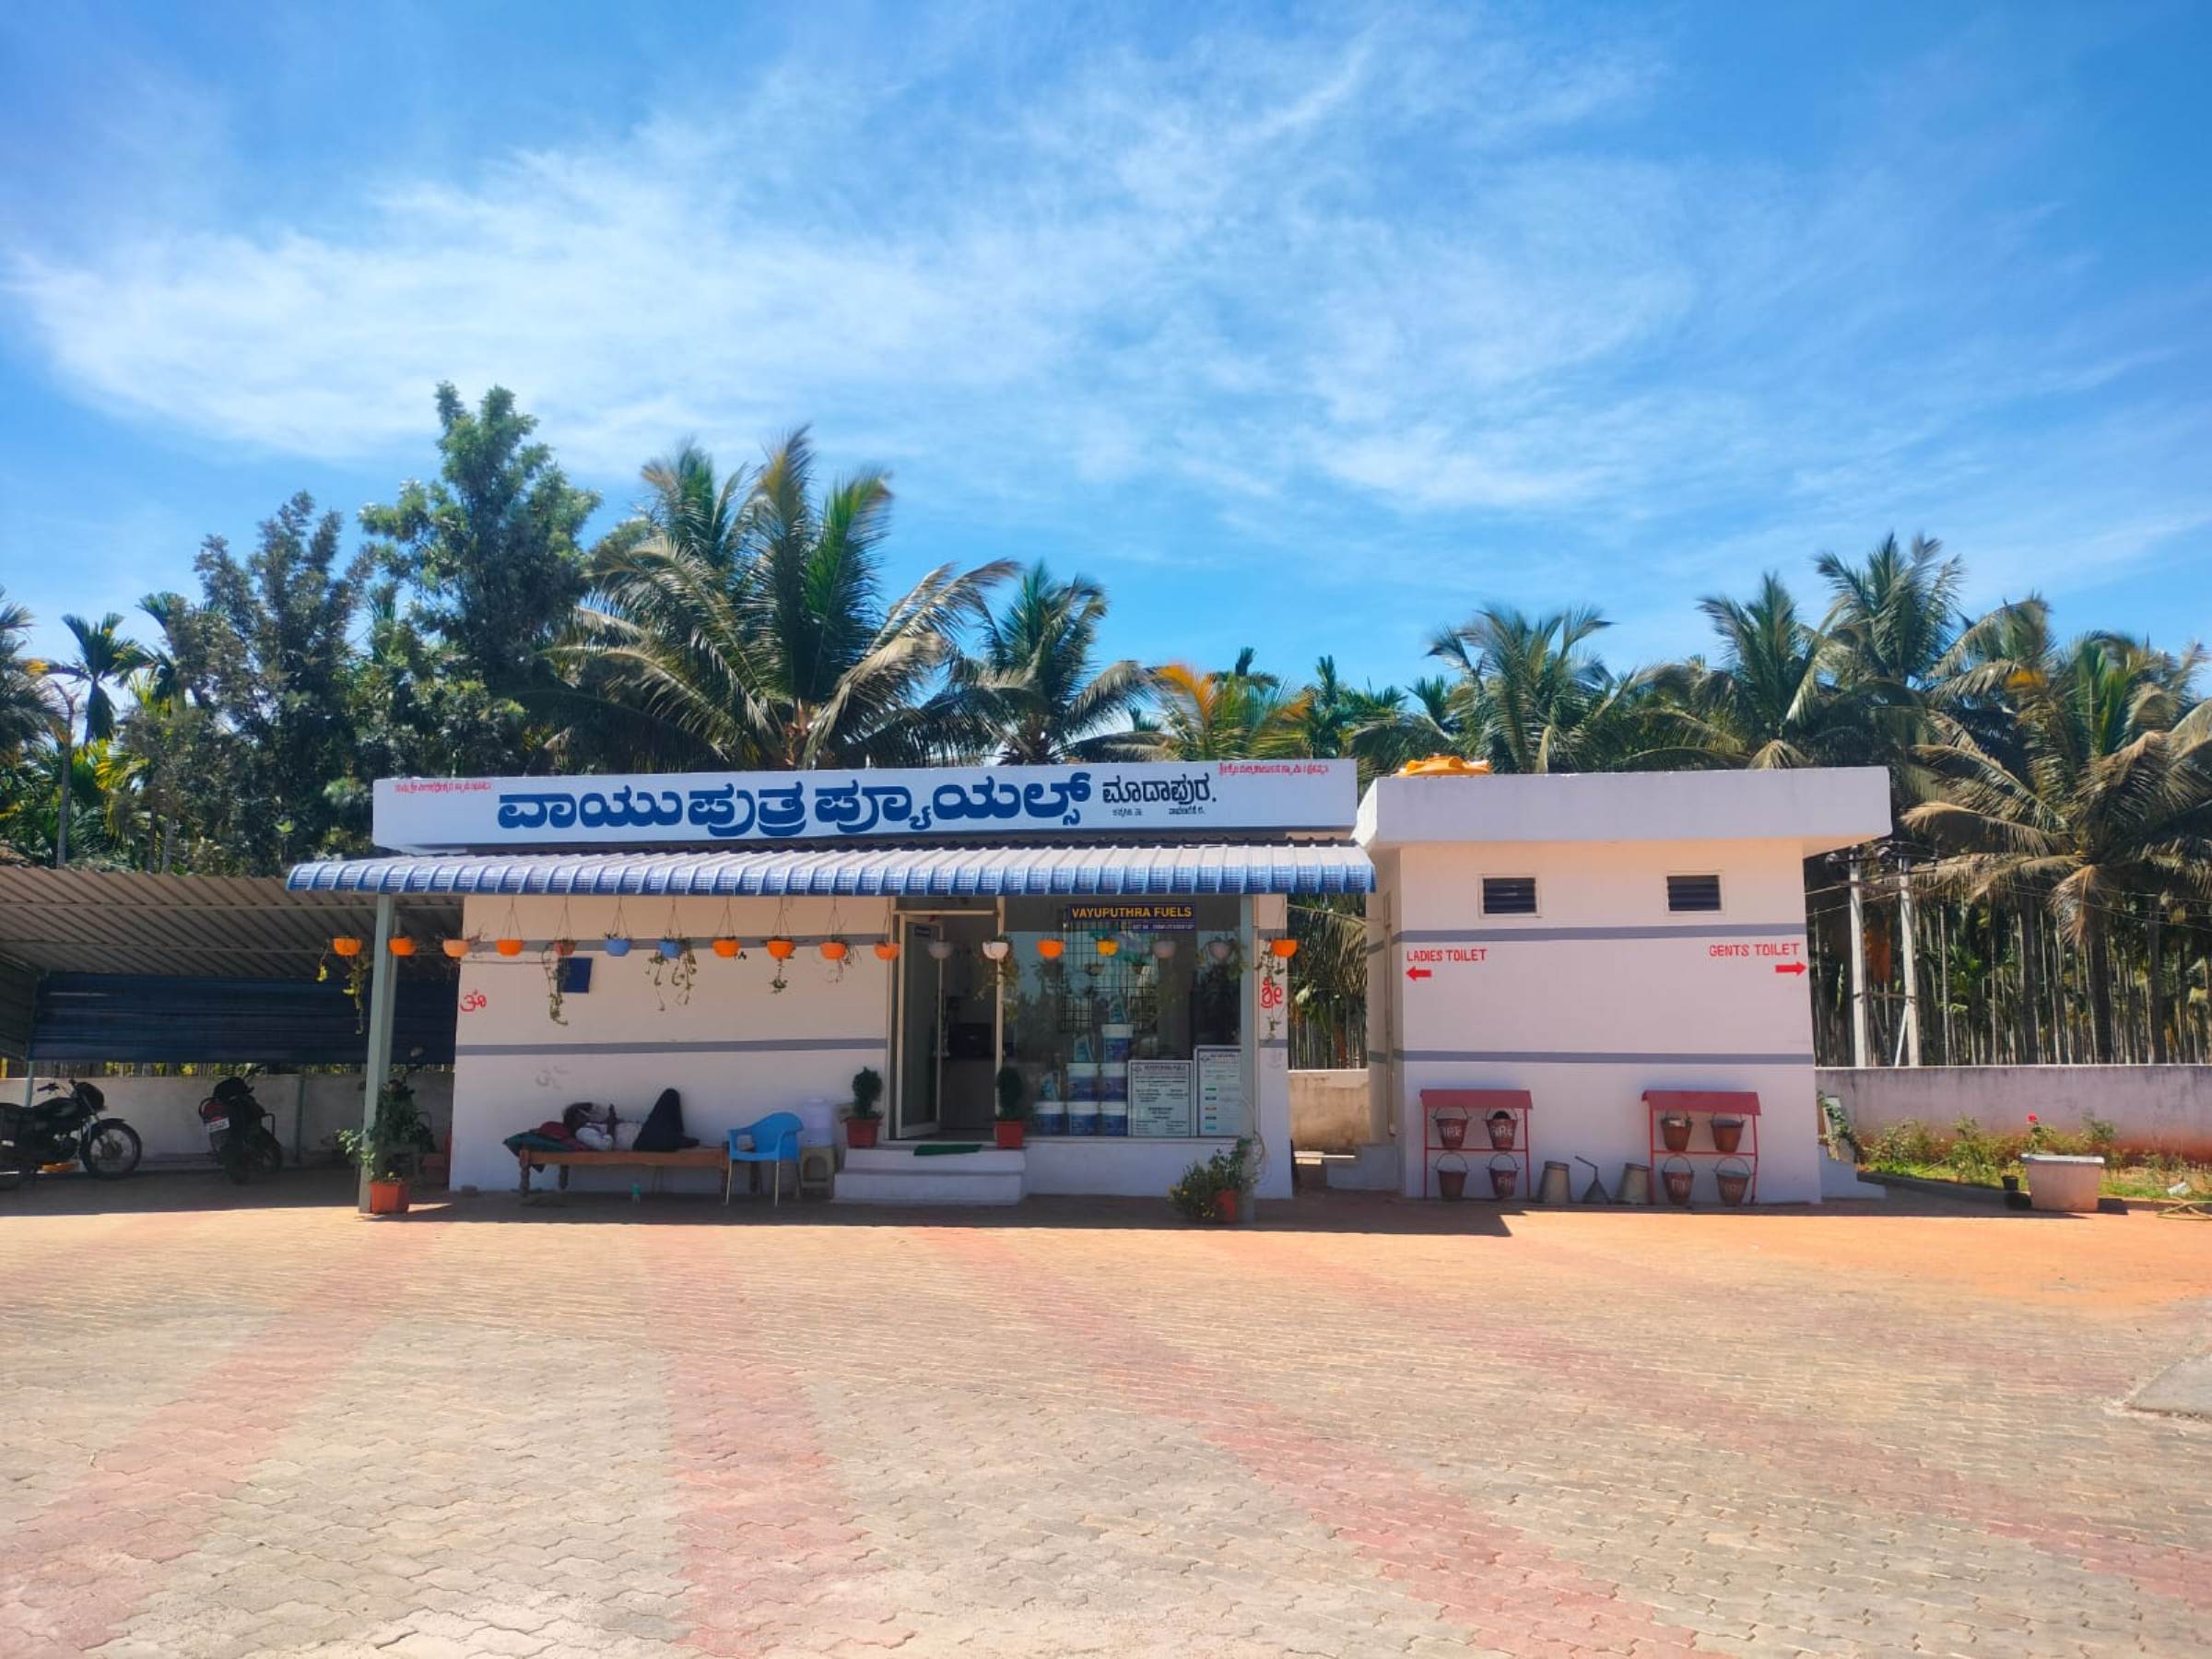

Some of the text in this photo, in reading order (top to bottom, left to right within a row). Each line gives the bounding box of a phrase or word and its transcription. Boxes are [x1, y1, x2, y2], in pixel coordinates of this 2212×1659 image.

[497, 781, 807, 837] ವಾಯುಪುತ್ರ
[1072, 906, 1192, 918] VAYUPUTHRA FUELS
[1406, 948, 1488, 961] LADIES TOILET
[1710, 942, 1800, 957] GENTS TOILET
